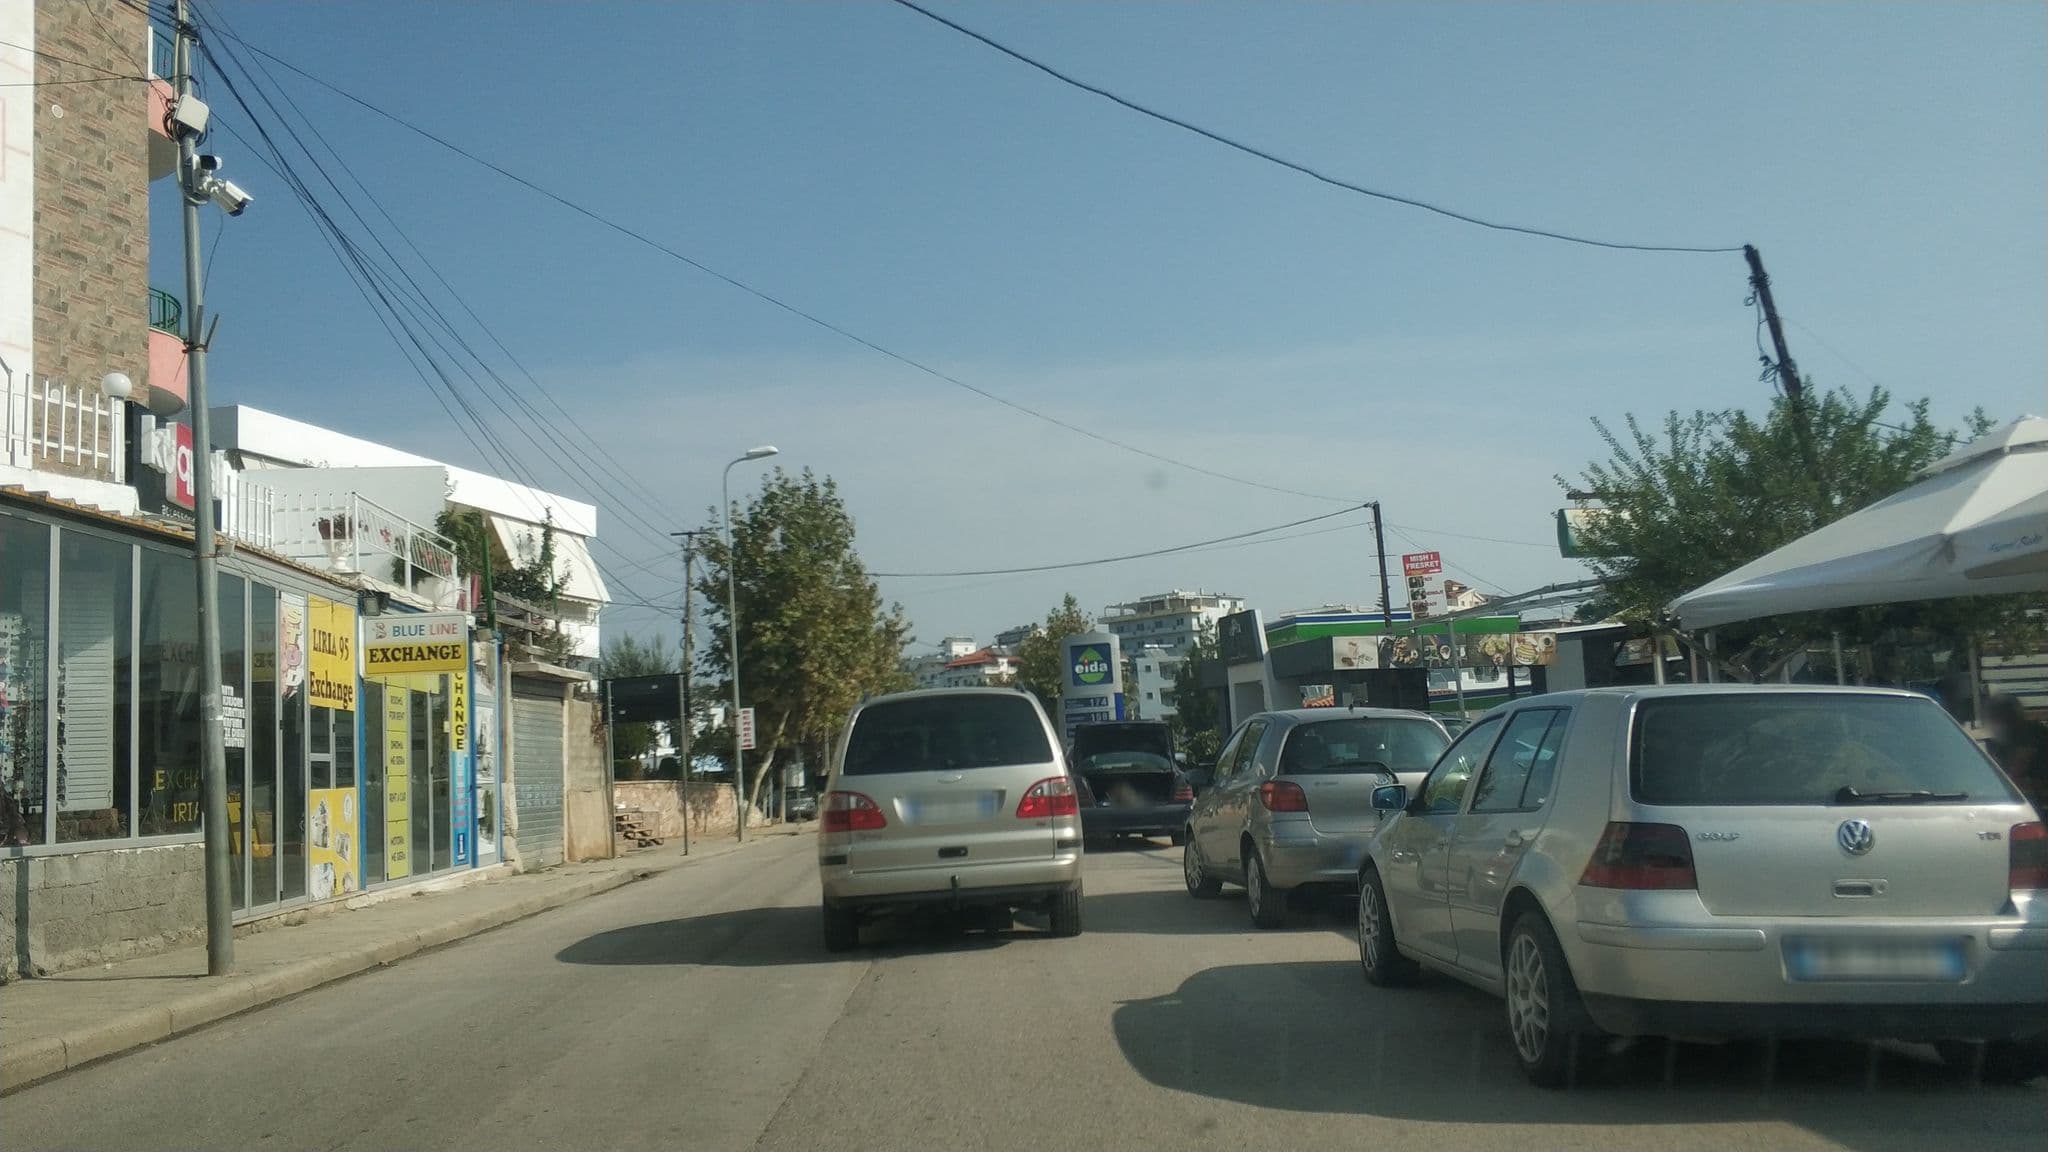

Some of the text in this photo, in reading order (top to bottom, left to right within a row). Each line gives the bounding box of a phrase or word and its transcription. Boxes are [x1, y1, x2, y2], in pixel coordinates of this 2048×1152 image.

[392, 623, 458, 637] BLUE LINE
[312, 628, 350, 661] LIRIA 95
[368, 644, 462, 663] EXCHANGE
[1075, 656, 1108, 674] eida
[309, 670, 353, 709] Exchange
